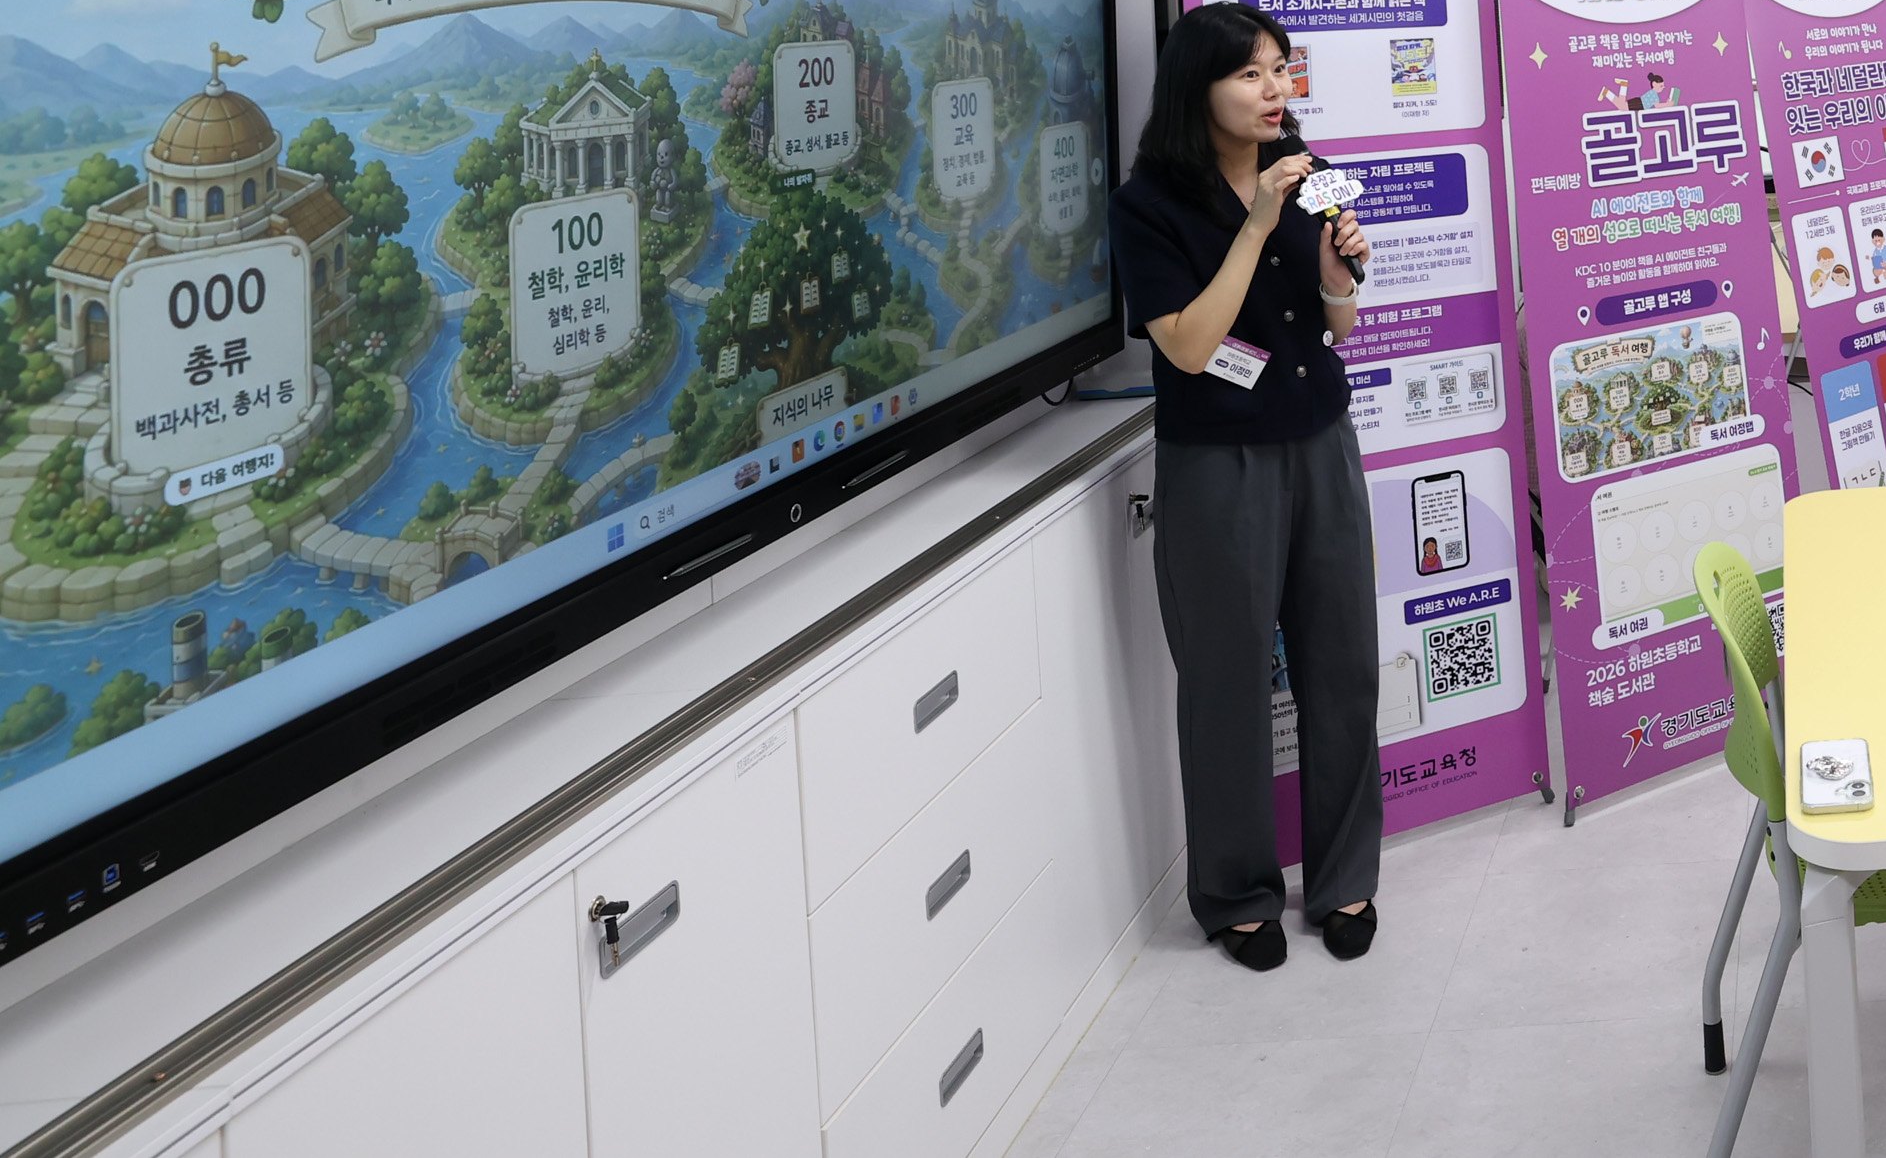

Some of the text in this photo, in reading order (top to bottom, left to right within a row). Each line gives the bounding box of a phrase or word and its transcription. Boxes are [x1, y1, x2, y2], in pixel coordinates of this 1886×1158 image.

[1277, 11, 1424, 26] 속에서 발견하는 세계시민의 첫걸음
[1569, 30, 1693, 52] 골고루 책을 읽으며 잡아가는
[1806, 23, 1877, 41] 서로의 이야기가 만나
[1592, 49, 1675, 68] 재미있는 독서여행
[1805, 42, 1859, 59] 우리의 이야기가
[798, 57, 834, 89] 200
[1782, 70, 1833, 99] 한국과
[804, 99, 830, 123] 종교
[950, 93, 977, 119] 300
[1786, 107, 1822, 134] 잇는
[1824, 98, 1873, 128] 우리의
[953, 124, 974, 146] 교육
[1054, 135, 1075, 159] 400
[1585, 104, 1743, 183] 골고루
[1310, 173, 1336, 190] 손잡고
[1370, 161, 1435, 178] 자립 프로젝트
[1531, 173, 1582, 193] 편독예방
[1307, 184, 1355, 209] RAS ON!
[1592, 186, 1704, 218] AI 에이전트와 함께
[551, 212, 603, 254] 100
[1553, 203, 1741, 250] 열 개의 섬으로 떠나는 독서 여행!
[528, 253, 625, 300] 철학, 윤리학
[1575, 253, 1664, 276] KDC 10 분야의 책을 AI
[1586, 271, 1637, 289] 즐거운 놀이와
[169, 267, 266, 329] 000
[1623, 289, 1692, 315] 골고루 앱 구성
[1873, 302, 1885, 314] 6월
[547, 296, 610, 329] 철학, 윤리,
[1364, 304, 1442, 326] 및 체험 프로그램
[552, 324, 607, 356] 심리학 등
[1853, 336, 1873, 350] 우리가
[1874, 333, 1886, 346] 함께
[184, 337, 252, 386] 총류
[1582, 347, 1609, 366] 골고루
[1610, 344, 1630, 357] 독서
[1631, 342, 1649, 354] 여행
[1230, 363, 1253, 379] 이정민
[1356, 375, 1371, 385] 미션
[1838, 384, 1861, 402] 2학년
[135, 378, 295, 441] 백과사전, 총서 등
[772, 386, 835, 427] 지식의 나무
[1710, 420, 1754, 442] 독서 여정맵
[1839, 429, 1851, 440] 한글
[201, 453, 275, 488] 다음 여행지!
[657, 503, 676, 524] 검색
[1414, 586, 1500, 617] 하원초 We A.R.E
[1608, 617, 1648, 639] 독서 여권
[1586, 636, 1702, 687] 2026 하원초등학교
[1588, 672, 1656, 708] 책숲 도서관
